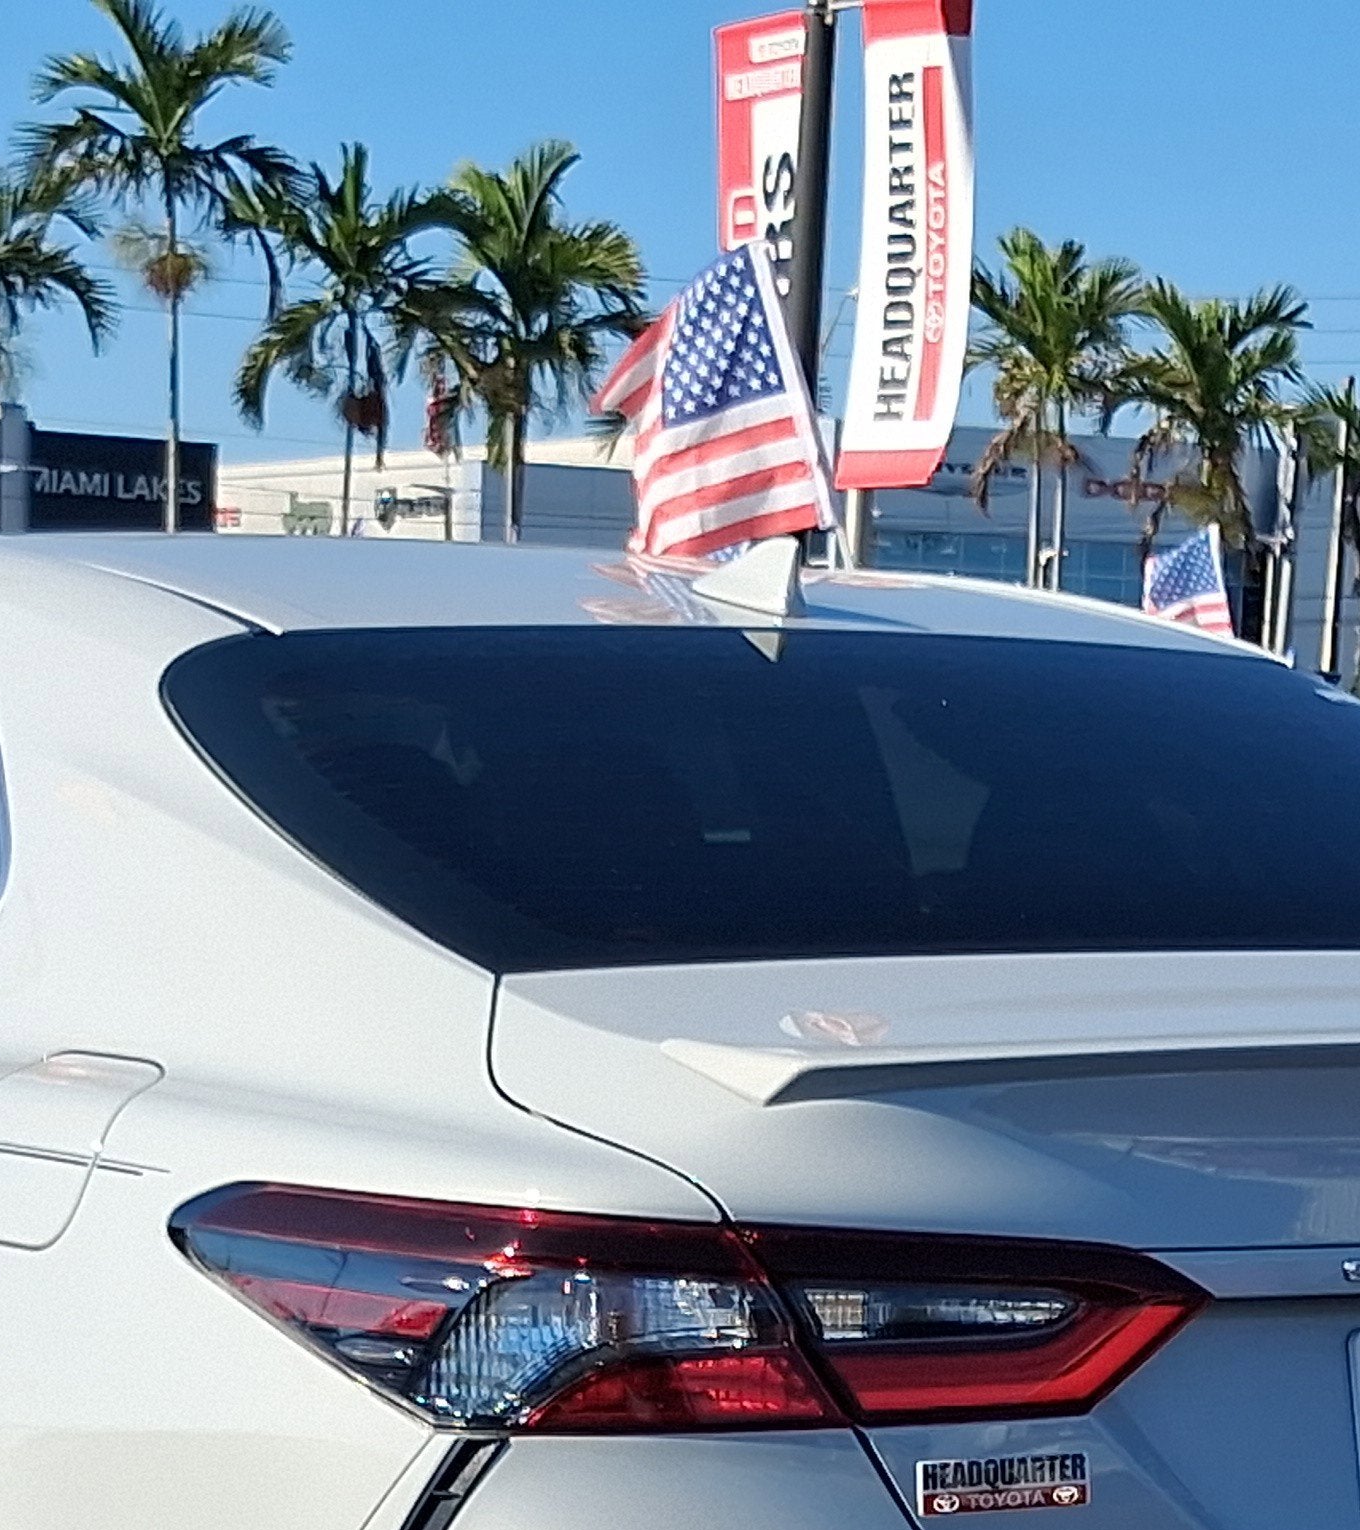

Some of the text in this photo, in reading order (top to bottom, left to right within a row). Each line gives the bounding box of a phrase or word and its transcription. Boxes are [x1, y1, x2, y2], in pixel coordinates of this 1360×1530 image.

[873, 71, 916, 423] HEADQUARTER
[925, 161, 945, 281] TOYOTA
[922, 1453, 1087, 1491] HEADQUARTER
[967, 1488, 1047, 1509] TOYOTA
